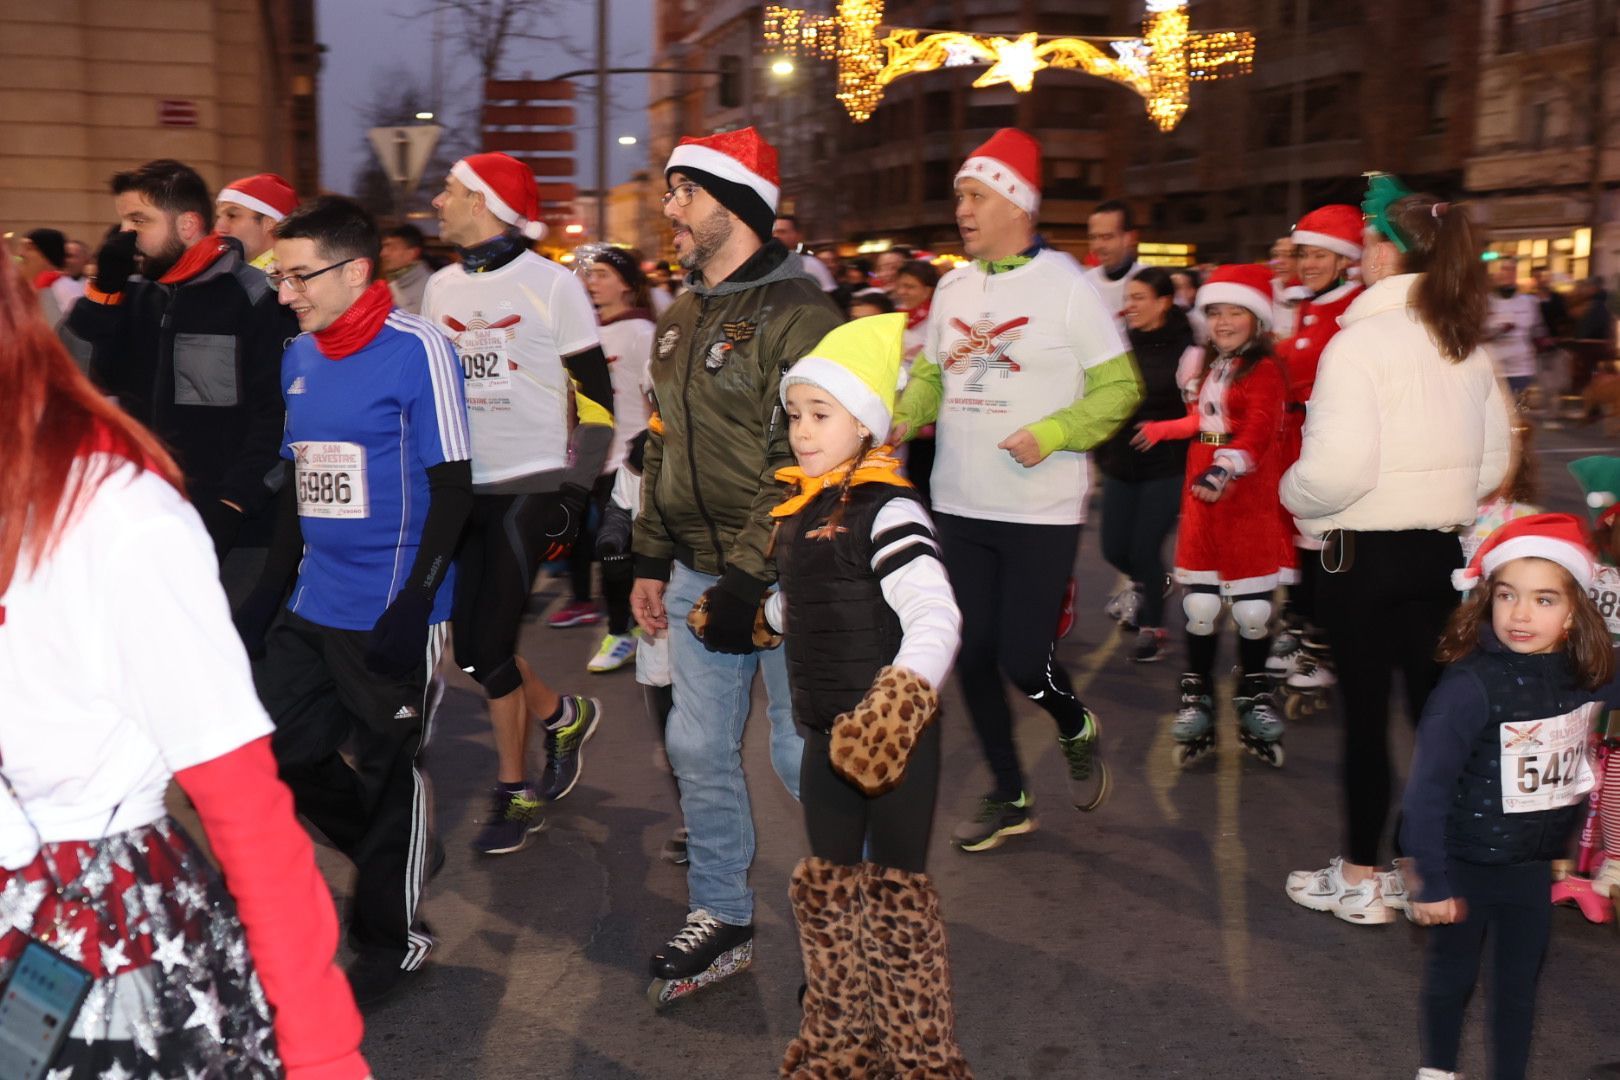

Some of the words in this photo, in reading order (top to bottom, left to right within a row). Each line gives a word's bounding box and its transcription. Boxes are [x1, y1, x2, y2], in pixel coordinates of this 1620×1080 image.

[462, 351, 500, 379] 092
[322, 444, 342, 453] SAN
[312, 454, 357, 463] SILVESTRE
[298, 471, 352, 504] 5986
